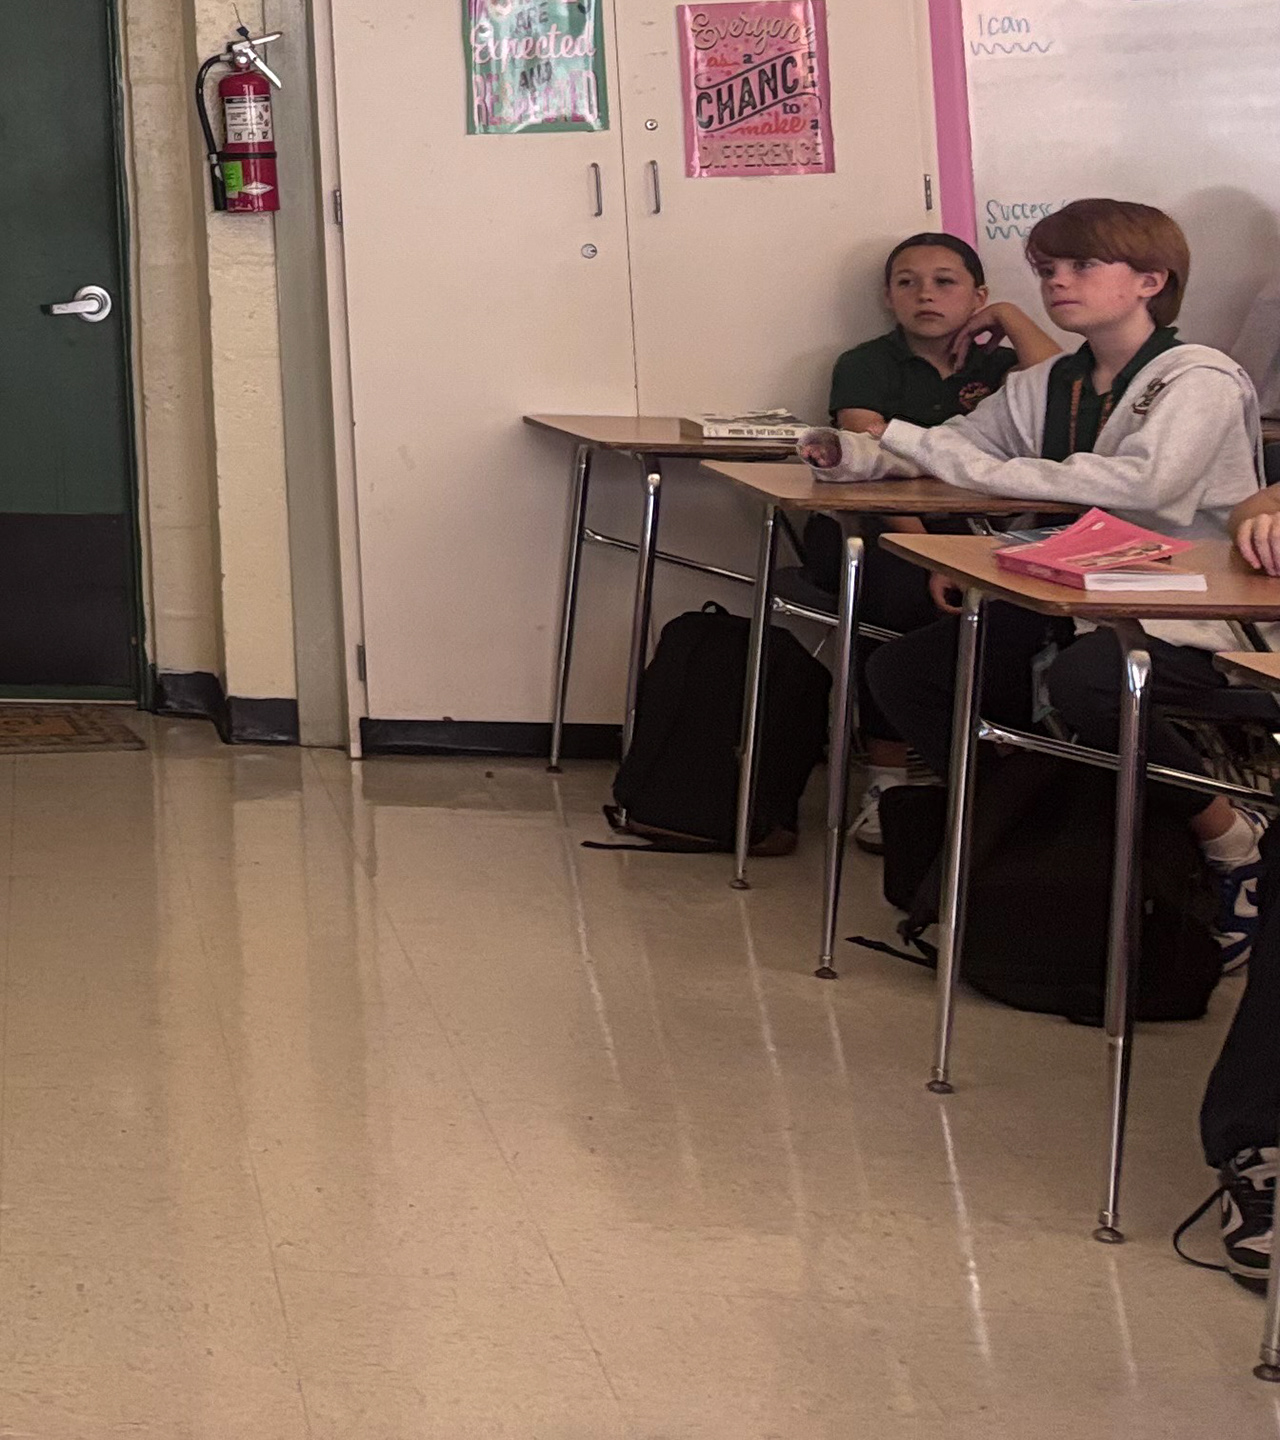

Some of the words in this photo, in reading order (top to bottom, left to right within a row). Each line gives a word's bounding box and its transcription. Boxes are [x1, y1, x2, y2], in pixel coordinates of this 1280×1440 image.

[691, 13, 818, 56] Everyone
[987, 14, 1031, 36] can
[470, 20, 597, 74] Expected
[696, 50, 818, 129] CHANCE
[728, 112, 808, 136] make
[783, 101, 801, 115] to
